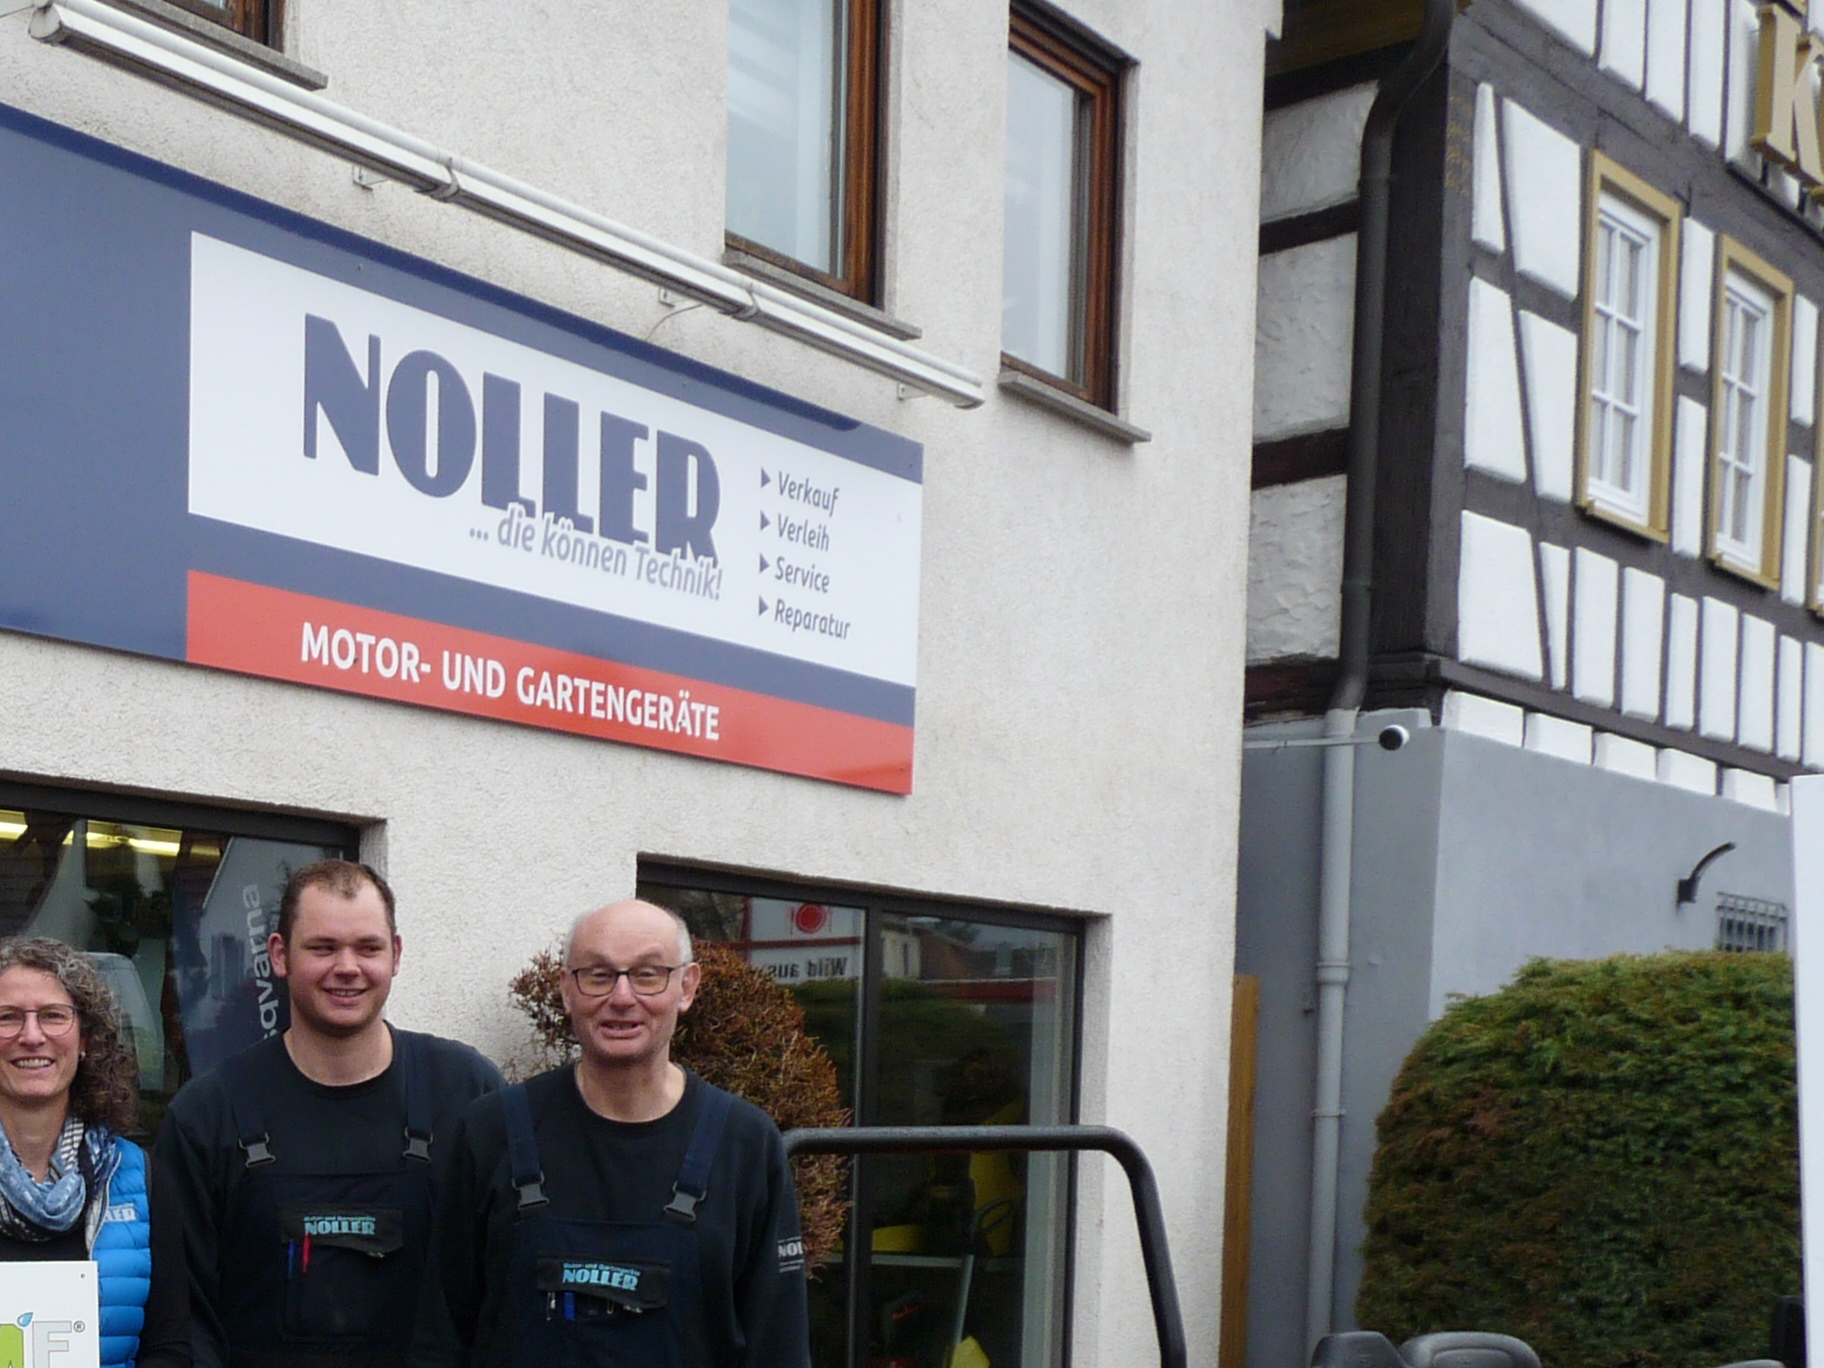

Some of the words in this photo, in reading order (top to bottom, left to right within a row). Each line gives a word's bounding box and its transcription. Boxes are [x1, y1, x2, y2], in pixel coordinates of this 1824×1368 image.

[303, 312, 722, 568] NOLLER
[778, 470, 840, 517] Verkauf
[497, 501, 534, 553] die
[541, 513, 627, 578] können
[635, 545, 723, 601] Technik!
[778, 513, 830, 552] Verleih
[774, 556, 830, 593] Service
[774, 598, 851, 640] Reparatur
[301, 622, 431, 682] MOTOR-
[442, 652, 506, 699] UND
[516, 667, 721, 741] GARTENGERÄTE
[242, 884, 280, 1040] qvarna
[304, 1221, 375, 1235] NOLLER
[562, 1268, 639, 1291] NOLLER
